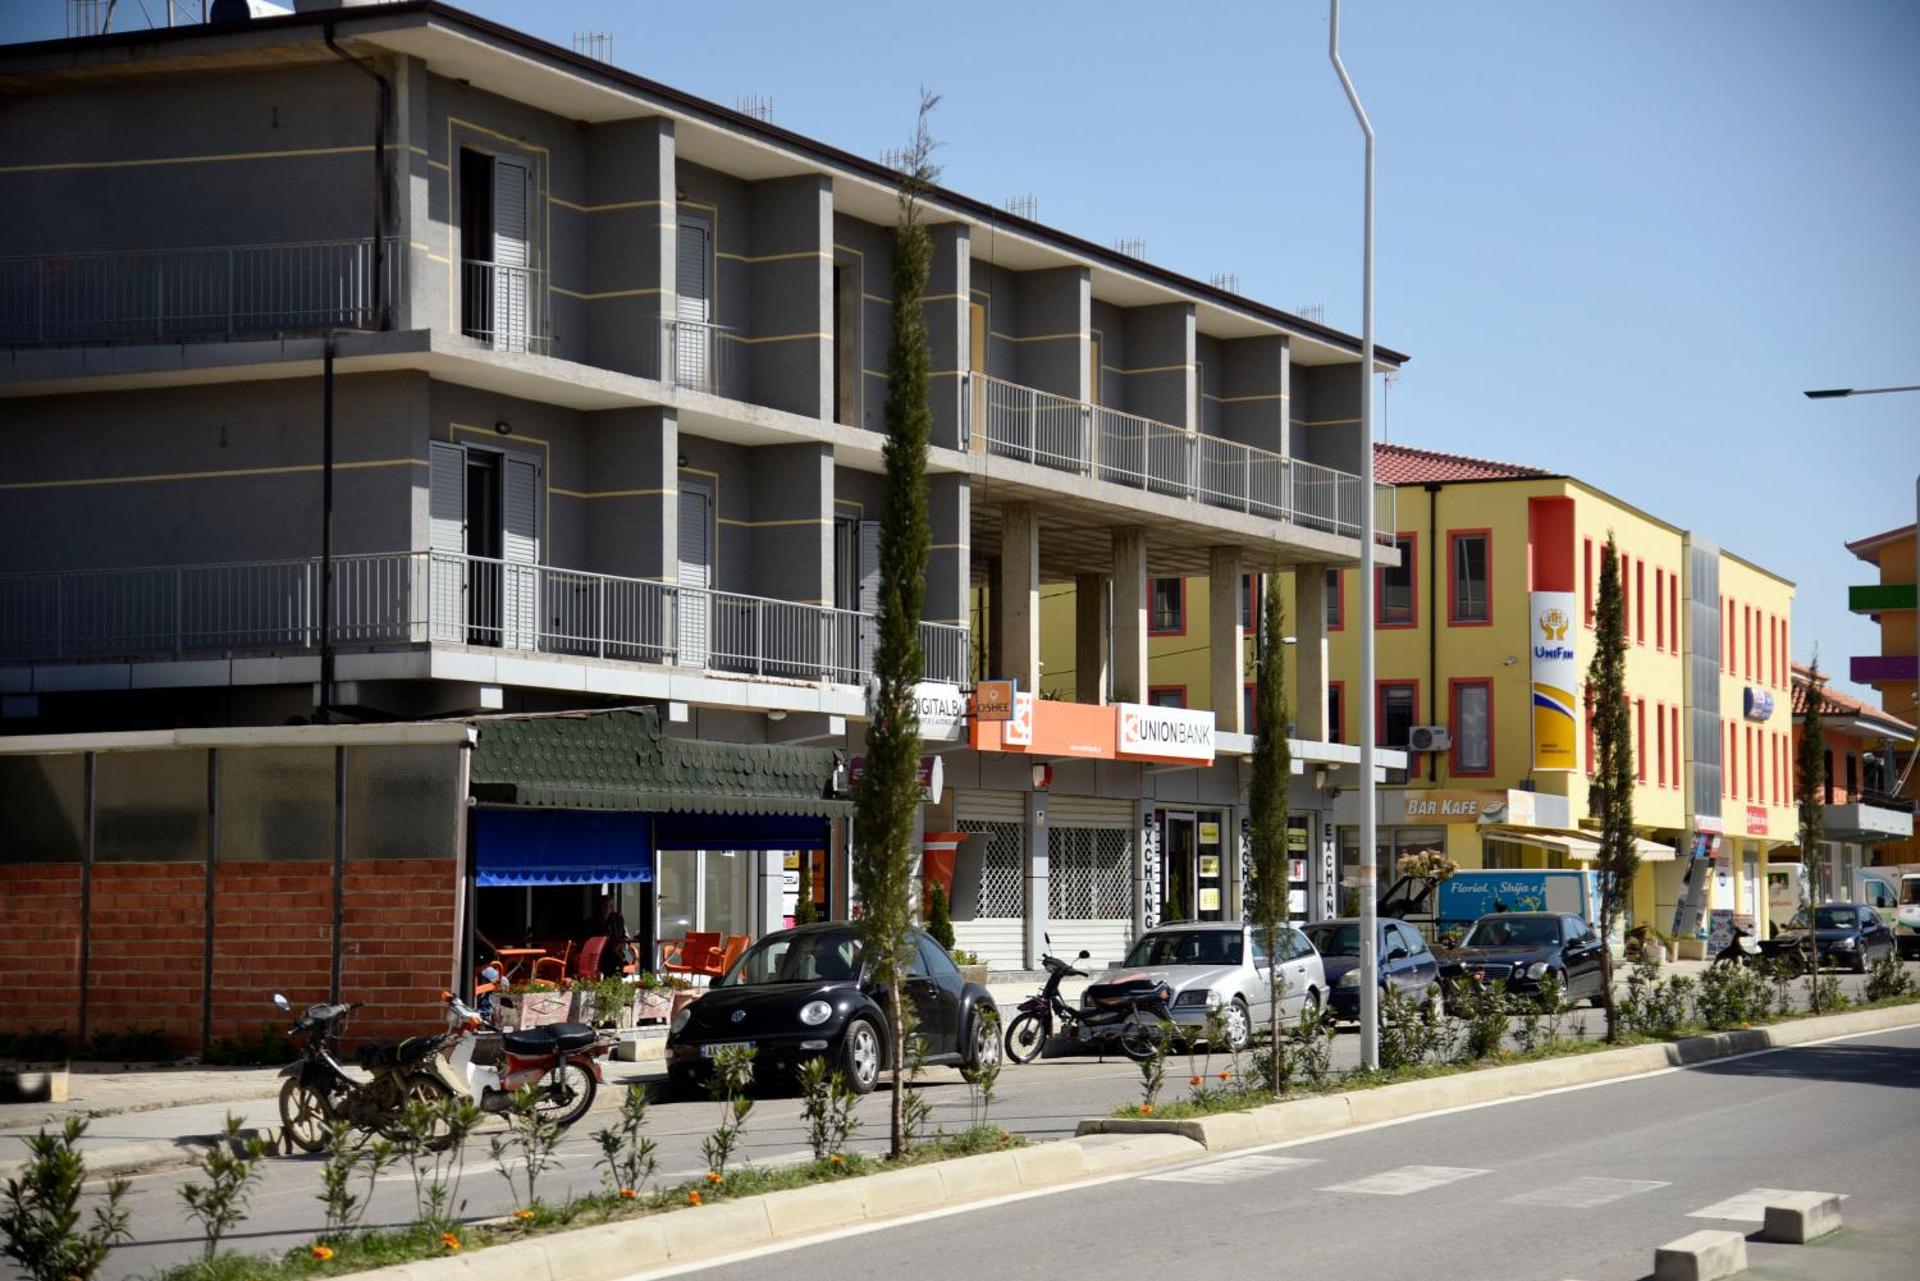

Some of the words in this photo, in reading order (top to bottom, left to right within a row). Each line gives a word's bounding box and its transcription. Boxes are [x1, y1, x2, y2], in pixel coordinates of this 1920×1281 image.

[976, 703, 1010, 713] OSHEE
[1407, 799, 1436, 815] BAR
[1441, 799, 1478, 815] KAFE
[1324, 823, 1334, 920] EXCHAN
